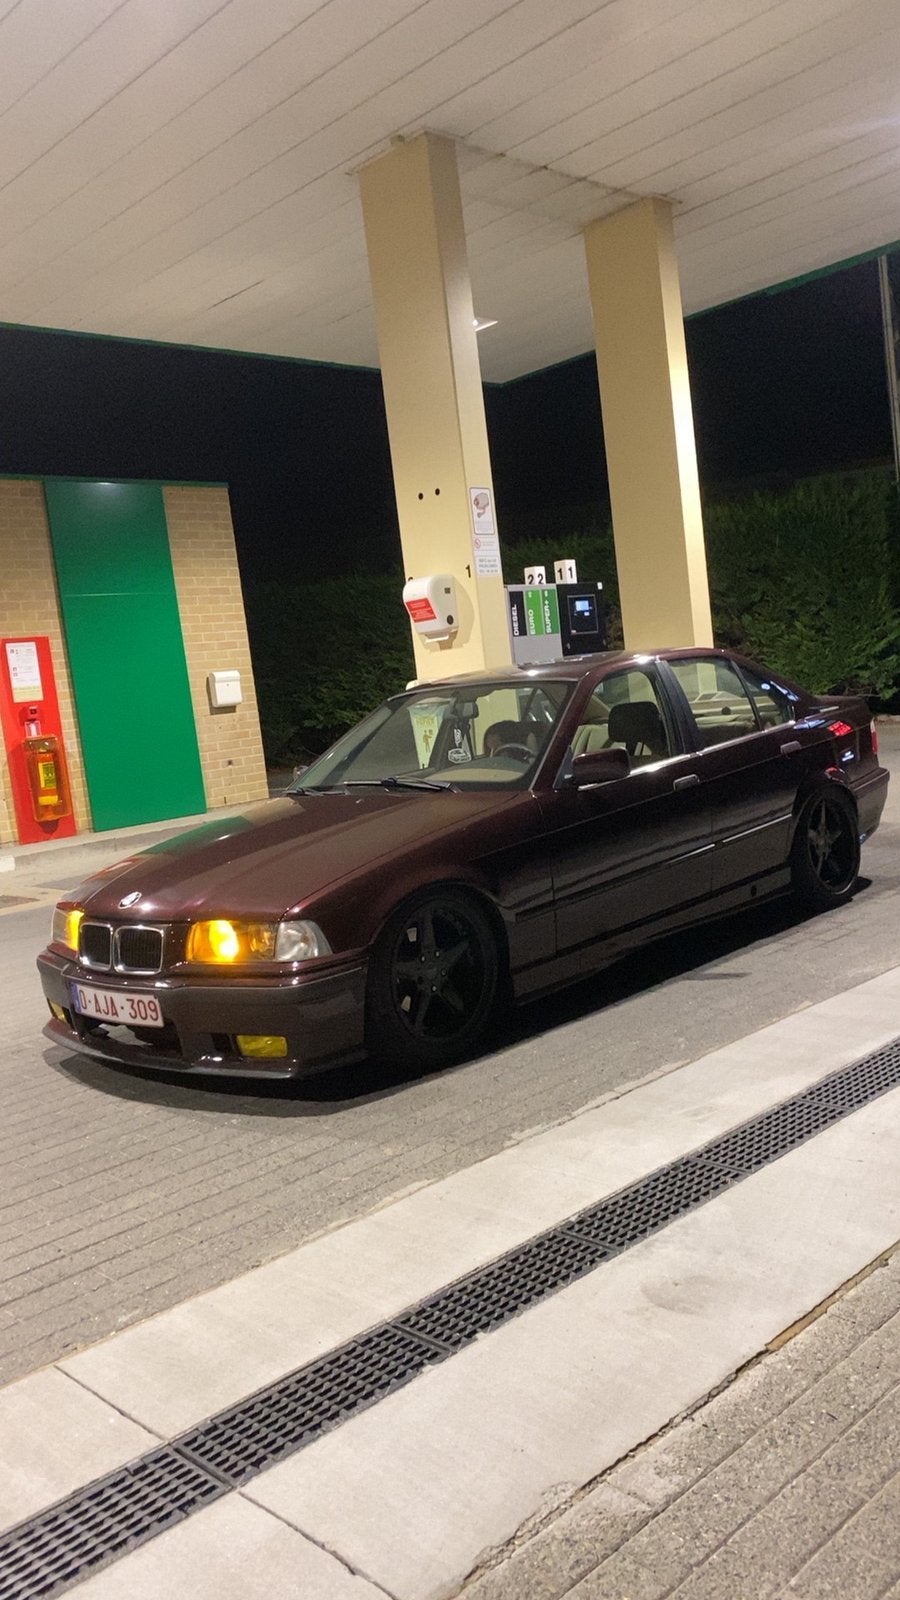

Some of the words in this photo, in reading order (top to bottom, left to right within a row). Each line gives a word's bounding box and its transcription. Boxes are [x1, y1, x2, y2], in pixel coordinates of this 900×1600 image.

[465, 564, 471, 578] 1
[557, 568, 563, 580] 1
[568, 566, 573, 579] 1
[527, 574, 535, 585] 2
[537, 573, 544, 585] 2
[511, 604, 520, 636] DIESEL
[528, 609, 536, 635] EURO
